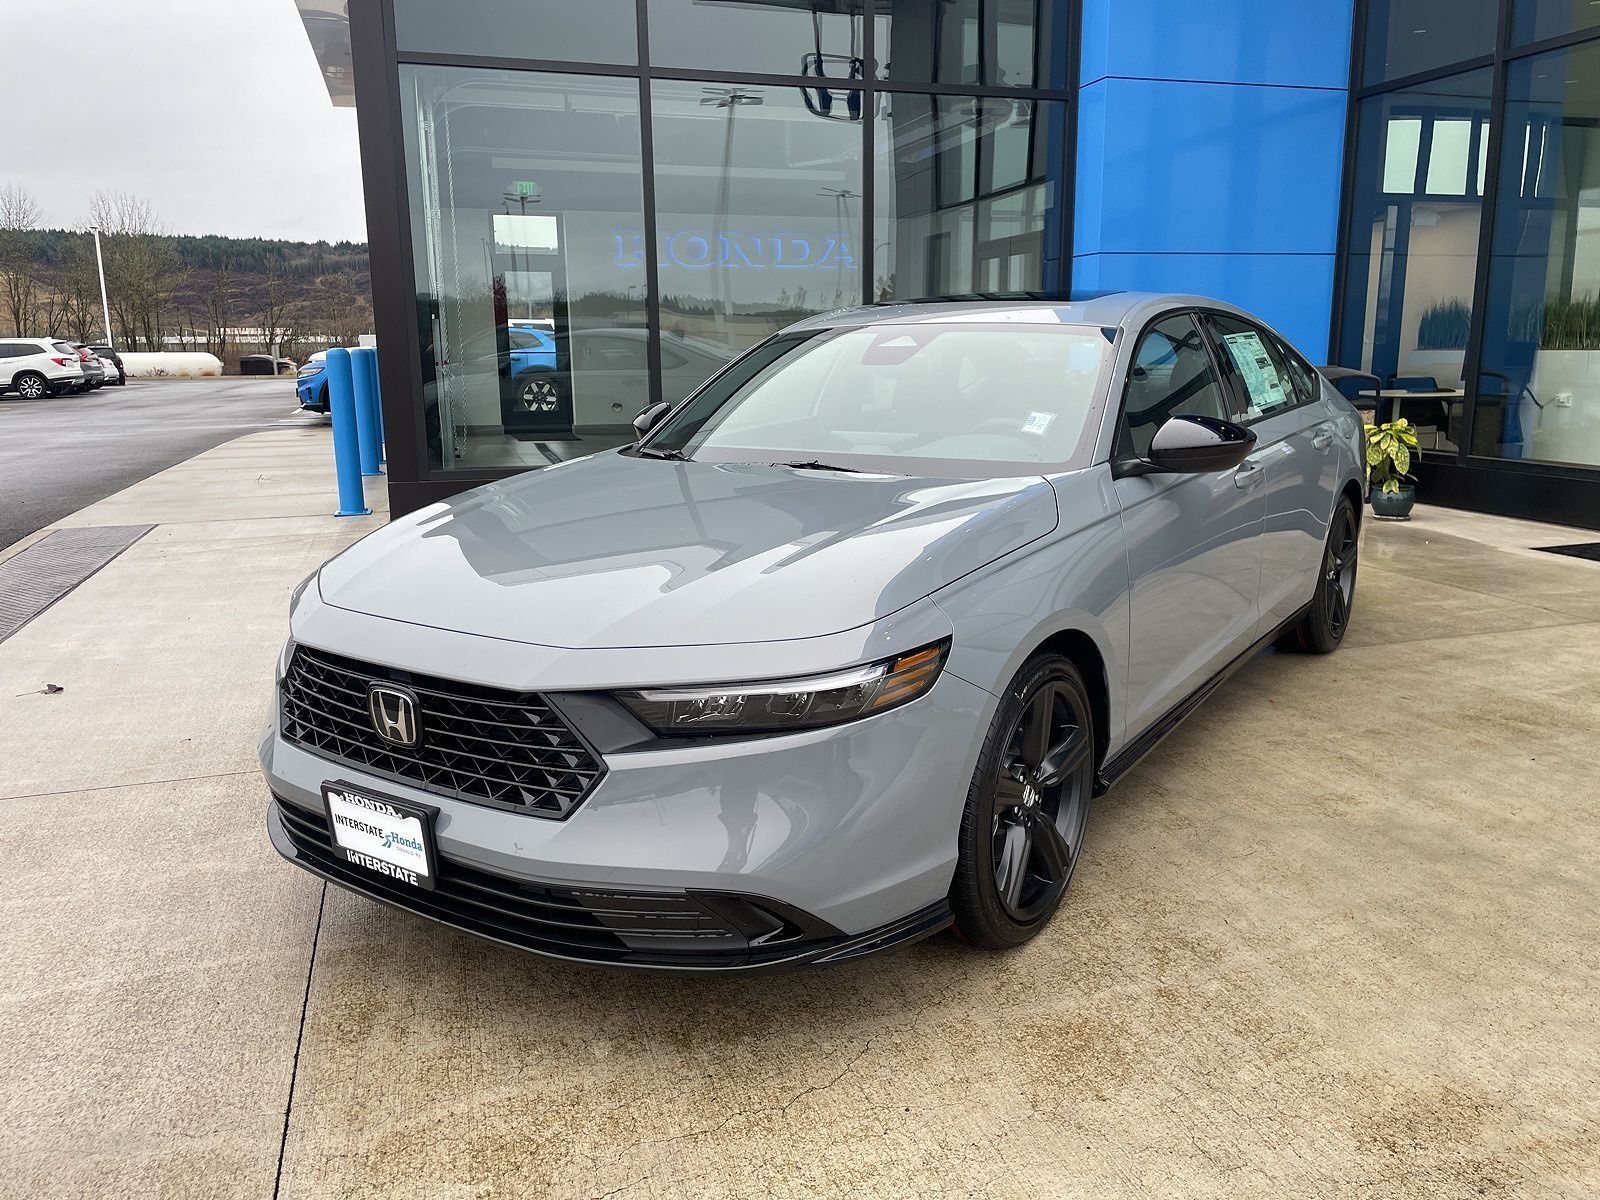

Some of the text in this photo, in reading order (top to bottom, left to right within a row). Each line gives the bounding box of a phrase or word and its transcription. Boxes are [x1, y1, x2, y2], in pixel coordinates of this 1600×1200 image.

[612, 228, 858, 267] HONDA
[342, 791, 399, 819] HONDA
[334, 813, 385, 839] INTERSTATE
[390, 831, 423, 851] Honda
[346, 849, 419, 886] INTERSTATE
